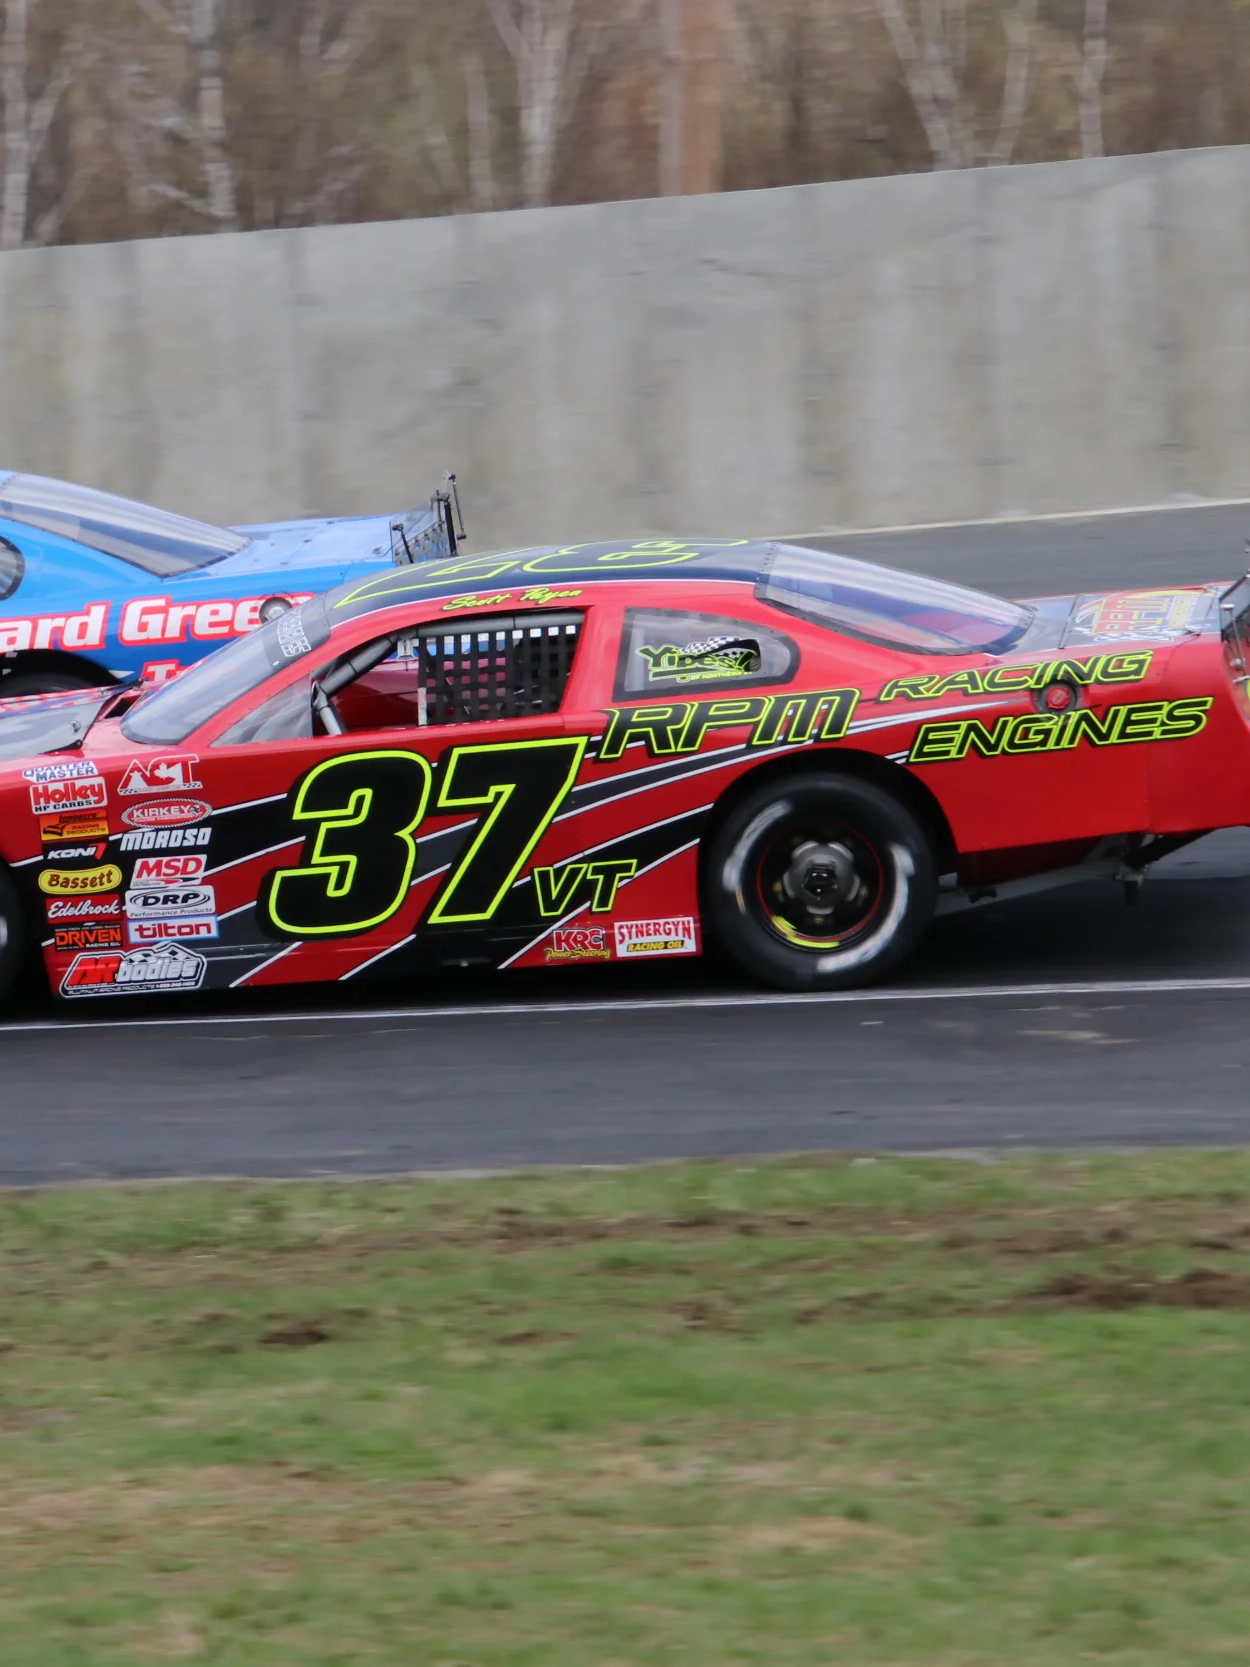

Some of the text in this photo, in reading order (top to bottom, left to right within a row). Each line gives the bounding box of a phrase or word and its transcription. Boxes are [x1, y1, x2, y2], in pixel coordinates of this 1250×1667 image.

[122, 594, 312, 645] Gree
[880, 650, 1155, 701] RACING
[598, 687, 861, 760] RPM
[908, 696, 1215, 762] ENGINES
[23, 761, 91, 777] QUARTER
[36, 766, 95, 782] MASTER
[118, 754, 200, 789] ACT
[31, 781, 105, 806] Holley
[53, 799, 93, 810] CARBS
[132, 804, 191, 818] KIRKEY
[66, 827, 106, 835] PRODUCTS
[120, 827, 213, 851] MOROSO
[267, 735, 590, 935] 37
[47, 846, 97, 860] KONI
[135, 856, 203, 879] MSD
[47, 869, 114, 889] Bassett
[532, 858, 637, 916] VT
[47, 899, 121, 919] Edelbrock
[141, 892, 201, 907] DRP
[130, 907, 213, 918] Performance Products
[55, 928, 122, 948] DRIVEN
[134, 922, 212, 939] tilton
[552, 927, 605, 952] KRC
[617, 919, 693, 945] SYNERGYN
[544, 947, 612, 961] Power Steering
[627, 940, 683, 952] RACING OIL
